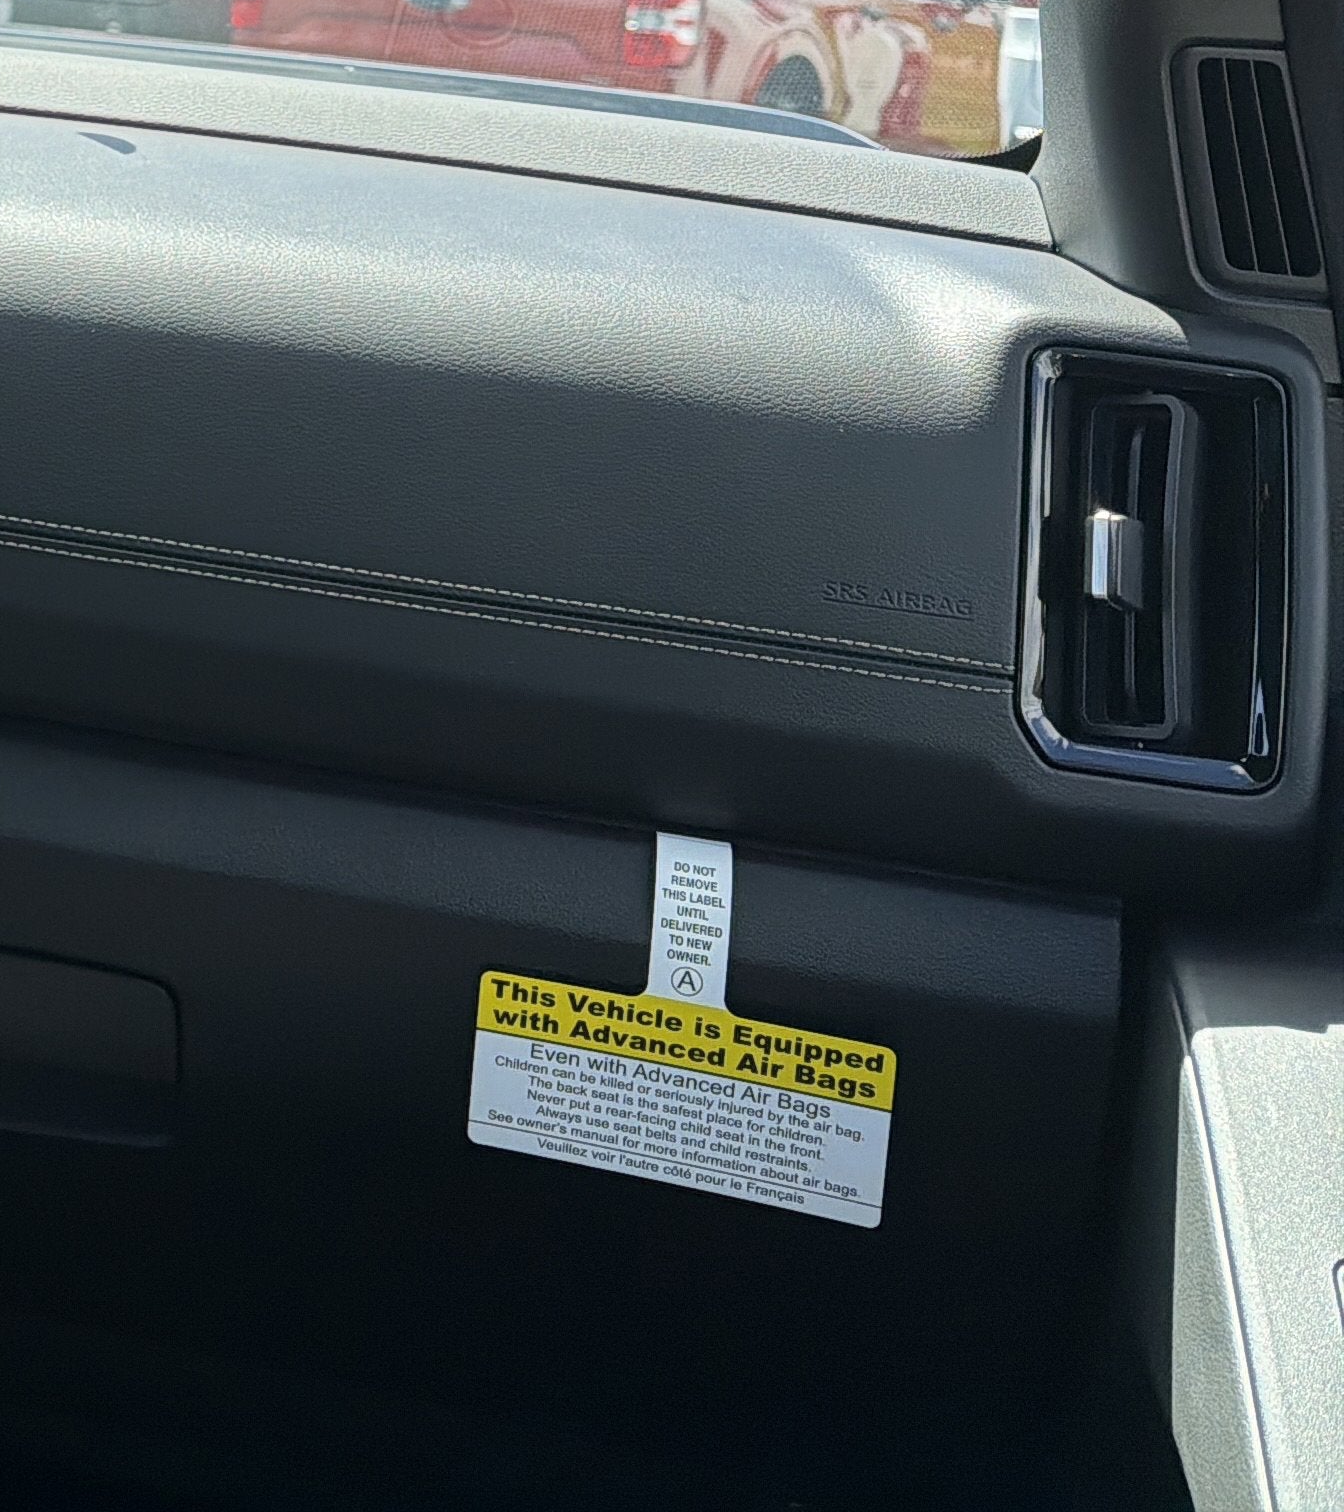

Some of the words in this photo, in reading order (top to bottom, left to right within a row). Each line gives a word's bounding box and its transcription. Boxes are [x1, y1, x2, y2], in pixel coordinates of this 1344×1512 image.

[822, 580, 867, 601] SRS
[875, 588, 973, 616] AIRBAG
[671, 875, 717, 891] REMOVE
[674, 861, 690, 872] DO
[693, 864, 716, 877] NOT
[663, 887, 685, 901] THIS
[689, 892, 723, 908] LABEL
[677, 906, 708, 920] UNTIL
[660, 918, 722, 937] DELIVERED
[670, 934, 683, 945] TO
[686, 937, 711, 950] NEW
[667, 949, 710, 966] OWNER.
[491, 978, 555, 1007] This
[568, 992, 682, 1031] Vehicle
[695, 1016, 720, 1039] is
[733, 1024, 883, 1073] Equipped
[493, 1009, 558, 1034] with
[569, 1020, 725, 1066] Advanced
[736, 1053, 783, 1077] Air
[794, 1063, 875, 1097] Bags
[495, 1055, 547, 1077] Children
[552, 1068, 575, 1081] can
[579, 1071, 595, 1086] be
[600, 1076, 633, 1094] killed
[637, 1085, 651, 1098] or
[654, 1088, 713, 1109] seriously
[717, 1099, 763, 1120] injured
[767, 1109, 783, 1124] by
[788, 1114, 809, 1128] the
[813, 1118, 831, 1132] air
[835, 1123, 863, 1141] bag.
[530, 1043, 579, 1066] Even
[587, 1057, 626, 1078] with
[632, 1063, 735, 1097] Advanced
[740, 1086, 771, 1104] Air
[777, 1092, 830, 1118] Bags
[530, 1075, 552, 1089] The
[556, 1080, 587, 1096] back
[591, 1090, 618, 1102] seat
[623, 1093, 633, 1105] is
[638, 1097, 658, 1110] the
[662, 1104, 702, 1119] safest
[706, 1112, 742, 1127] place
[747, 1119, 765, 1132] for
[769, 1124, 825, 1146] children.
[487, 1109, 512, 1123] See
[516, 1117, 566, 1134] owner's
[570, 1127, 618, 1144] manual
[622, 1136, 640, 1148] for
[643, 1142, 677, 1156] more
[681, 1149, 755, 1173] information
[759, 1167, 798, 1183] about
[802, 1176, 820, 1187] air
[824, 1179, 857, 1196] bags.
[537, 1137, 587, 1157] Veuillez
[591, 1150, 615, 1163] voir
[619, 1154, 658, 1172] l'autre
[663, 1165, 691, 1178] côté
[695, 1173, 726, 1186] pour
[730, 1178, 741, 1190] le
[746, 1181, 804, 1204] Français
